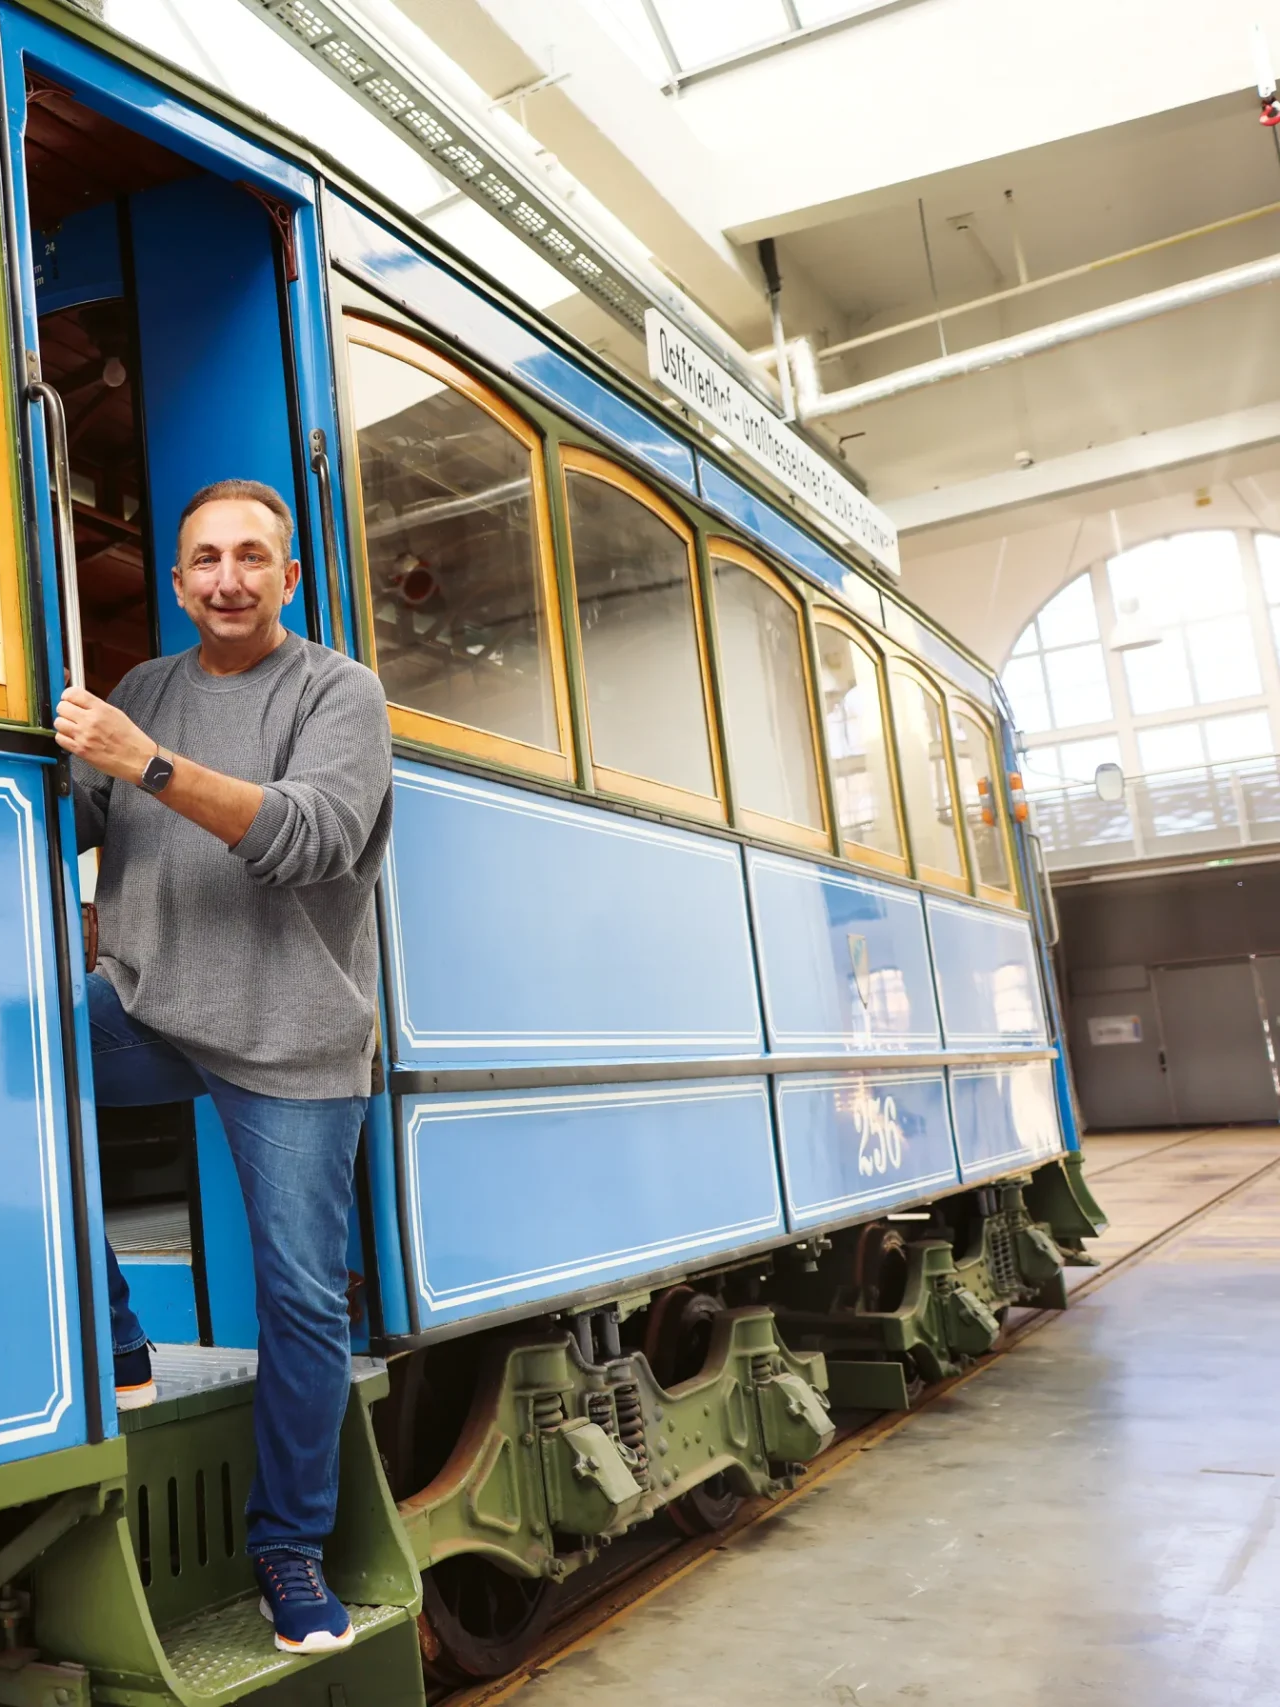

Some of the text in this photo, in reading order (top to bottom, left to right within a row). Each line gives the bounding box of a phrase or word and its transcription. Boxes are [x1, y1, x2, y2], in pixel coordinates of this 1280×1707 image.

[45, 241, 56, 256] 24
[659, 327, 733, 427] Ostfriedhof
[853, 1096, 902, 1177] 256
